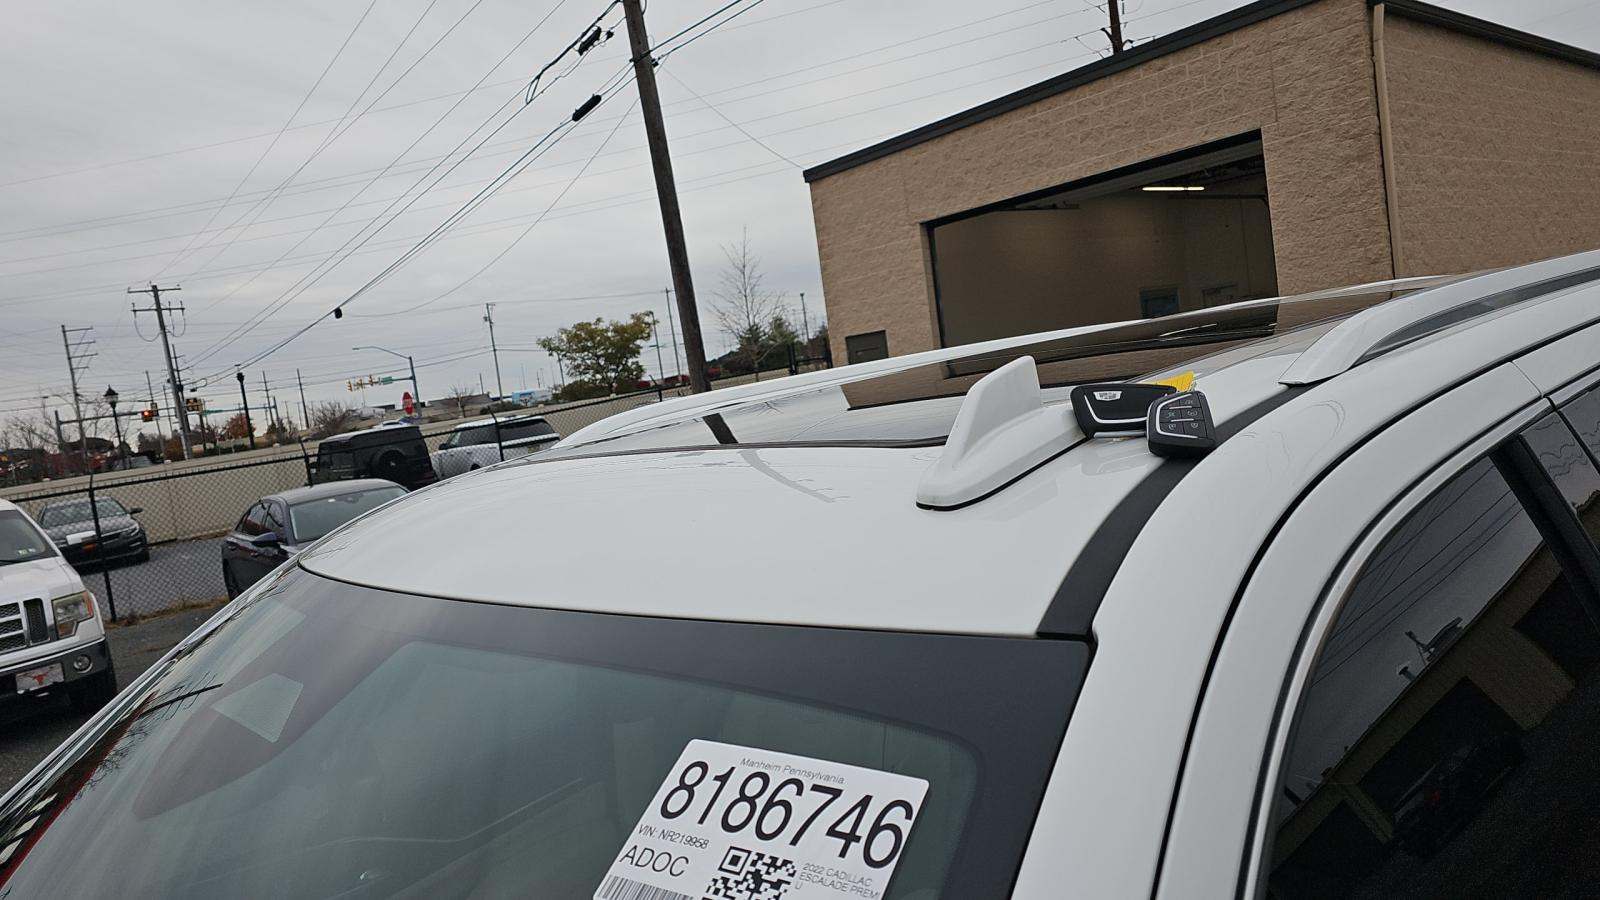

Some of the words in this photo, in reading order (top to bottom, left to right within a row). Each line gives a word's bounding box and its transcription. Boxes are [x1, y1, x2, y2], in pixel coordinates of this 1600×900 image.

[740, 758, 781, 772] Manheim
[783, 765, 845, 784] Pennsylvania
[660, 760, 913, 869] 8186746
[638, 825, 656, 838] VIN:
[658, 829, 709, 849] NR219958
[619, 845, 689, 877] ADOC
[799, 872, 849, 892] ESCALADE
[802, 863, 825, 875] 2022
[826, 868, 873, 887] CADILLAC
